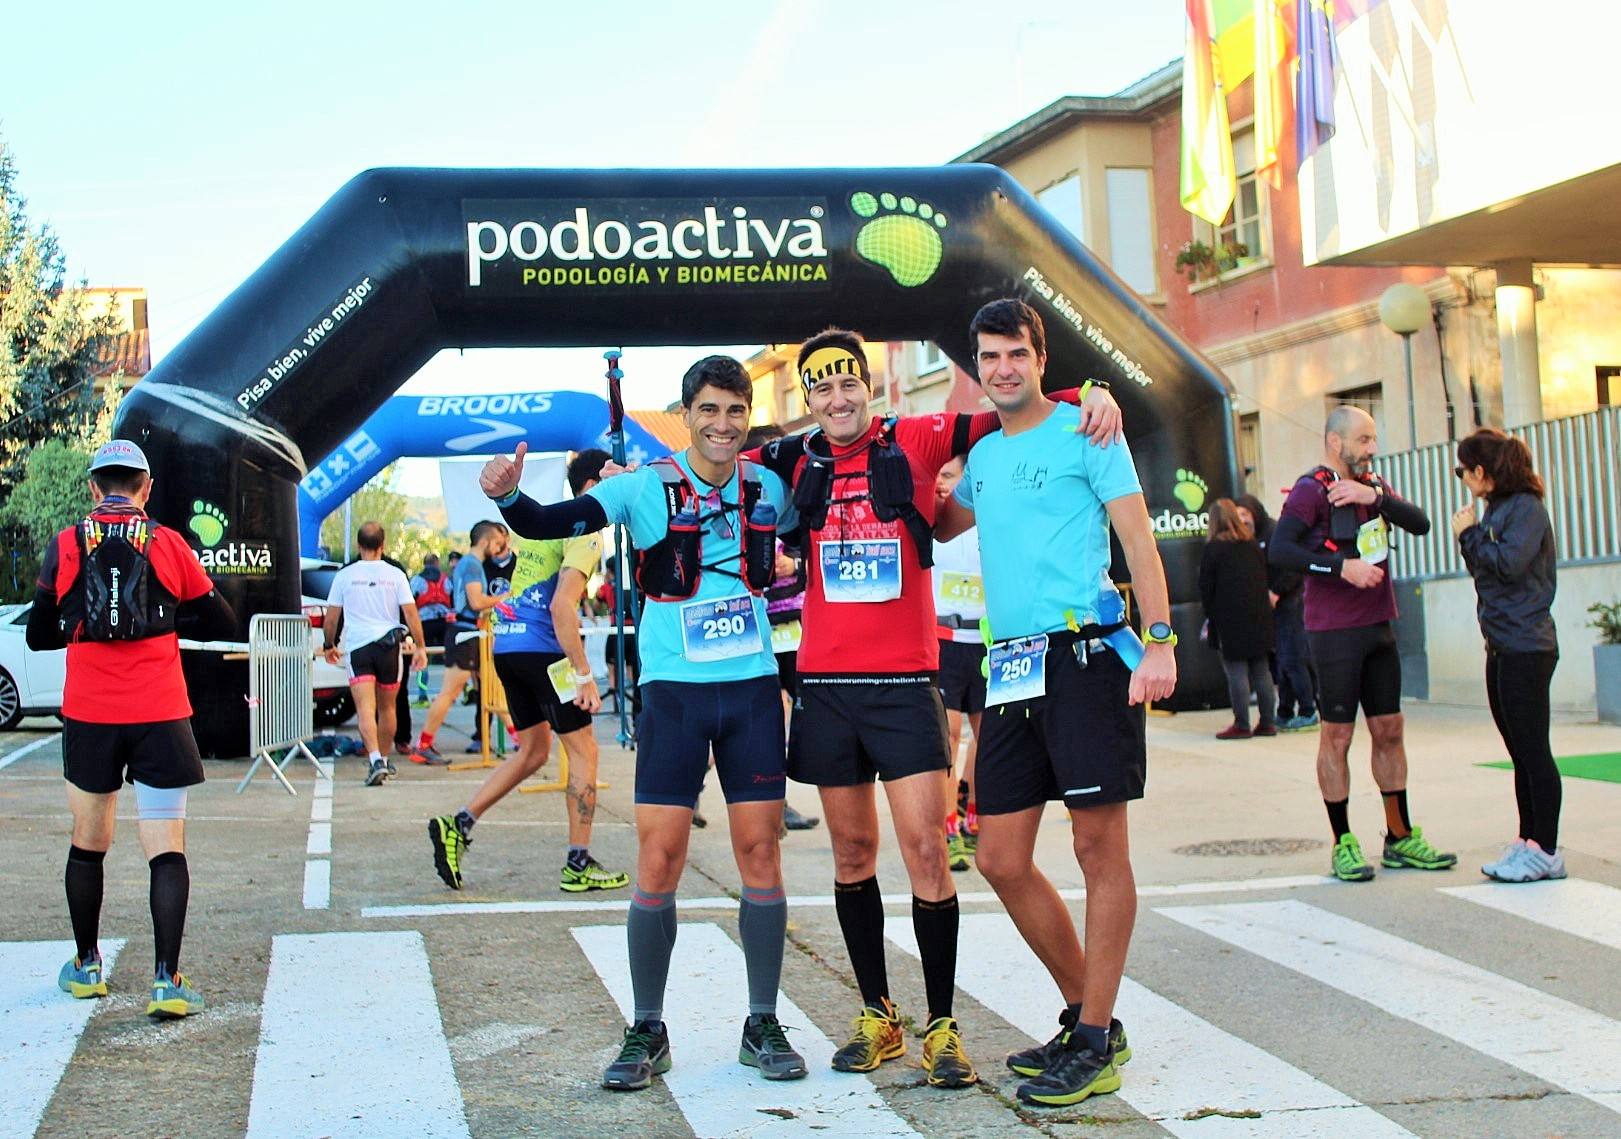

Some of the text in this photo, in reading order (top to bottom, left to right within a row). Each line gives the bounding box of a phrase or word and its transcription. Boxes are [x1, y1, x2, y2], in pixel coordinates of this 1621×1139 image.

[523, 260, 828, 286] PODOLOGÍA Y BIOMECÁNICA
[1023, 266, 1055, 301] Pisa
[1085, 323, 1114, 354] vive
[1110, 348, 1154, 388] mejor
[236, 276, 373, 411] Pisa bien, vive mejor
[416, 391, 555, 418] BROOKS
[838, 559, 879, 581] 281
[702, 614, 746, 641] 290
[1000, 656, 1032, 683] 250
